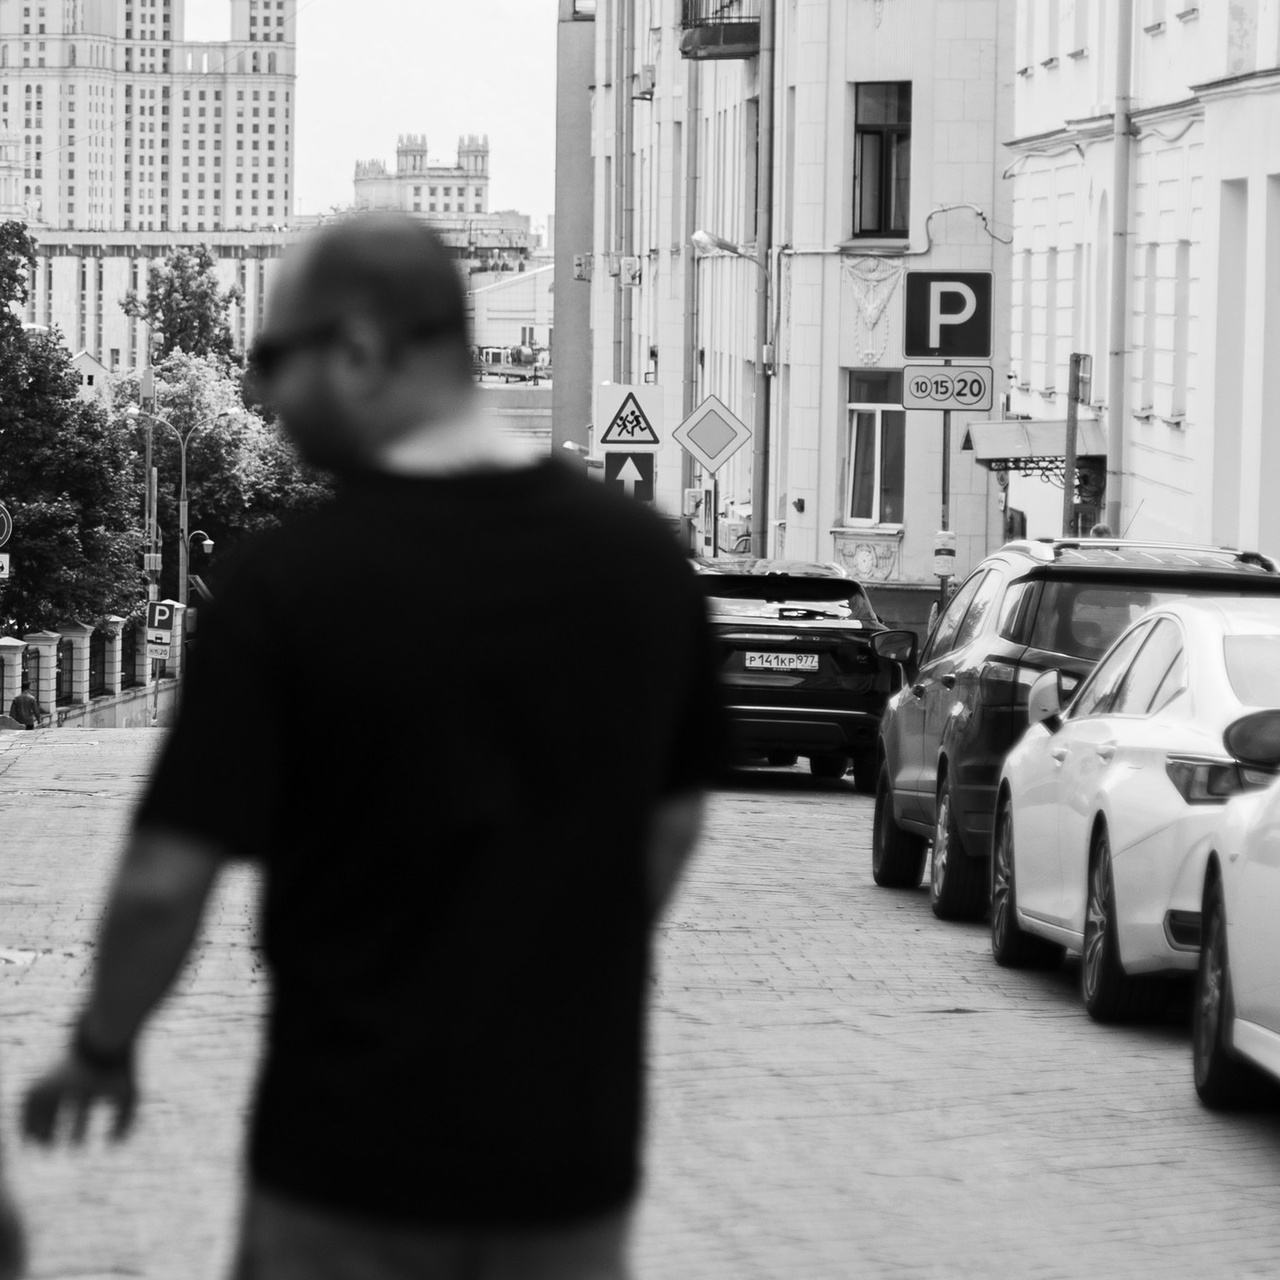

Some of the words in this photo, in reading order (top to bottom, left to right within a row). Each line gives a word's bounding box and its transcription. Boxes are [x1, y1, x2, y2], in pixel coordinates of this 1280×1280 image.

[929, 281, 977, 348] P
[915, 381, 928, 393] 10
[933, 380, 949, 395] 15
[956, 378, 982, 397] 20
[154, 605, 170, 627] P
